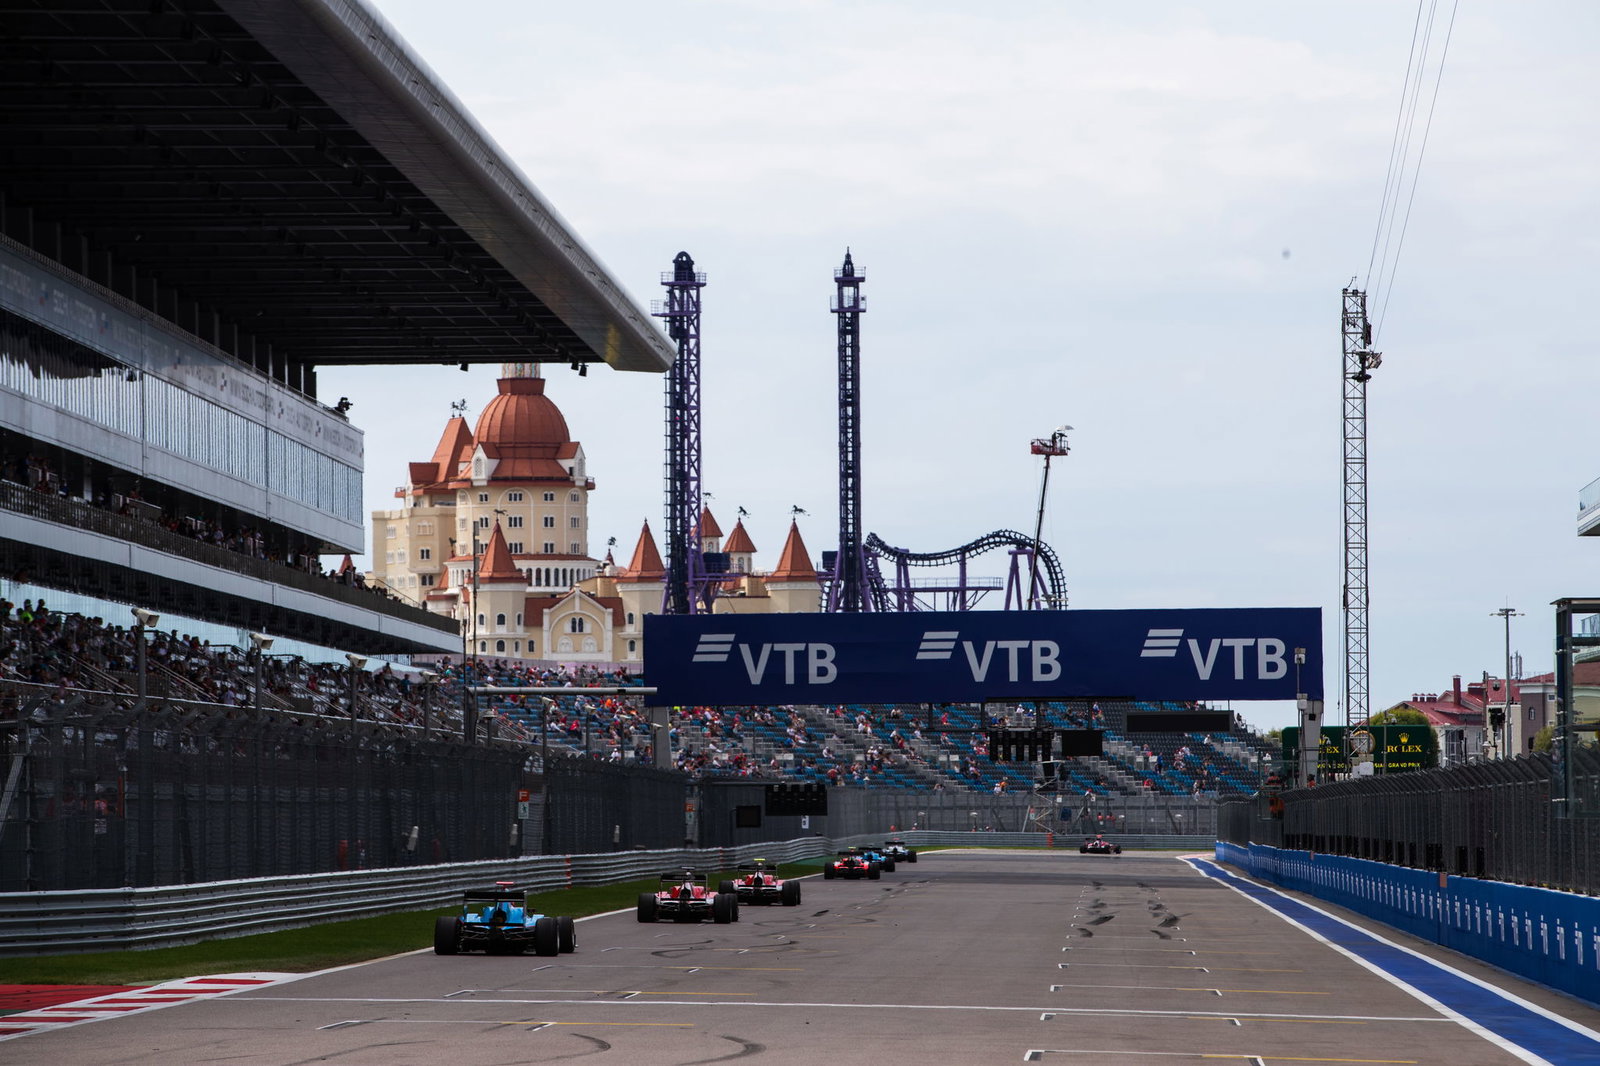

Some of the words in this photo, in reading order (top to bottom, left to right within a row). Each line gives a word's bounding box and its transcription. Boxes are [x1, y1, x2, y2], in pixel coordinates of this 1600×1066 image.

[739, 643, 838, 685] VTB
[962, 640, 1062, 682] VTB
[1187, 637, 1288, 681] VTB
